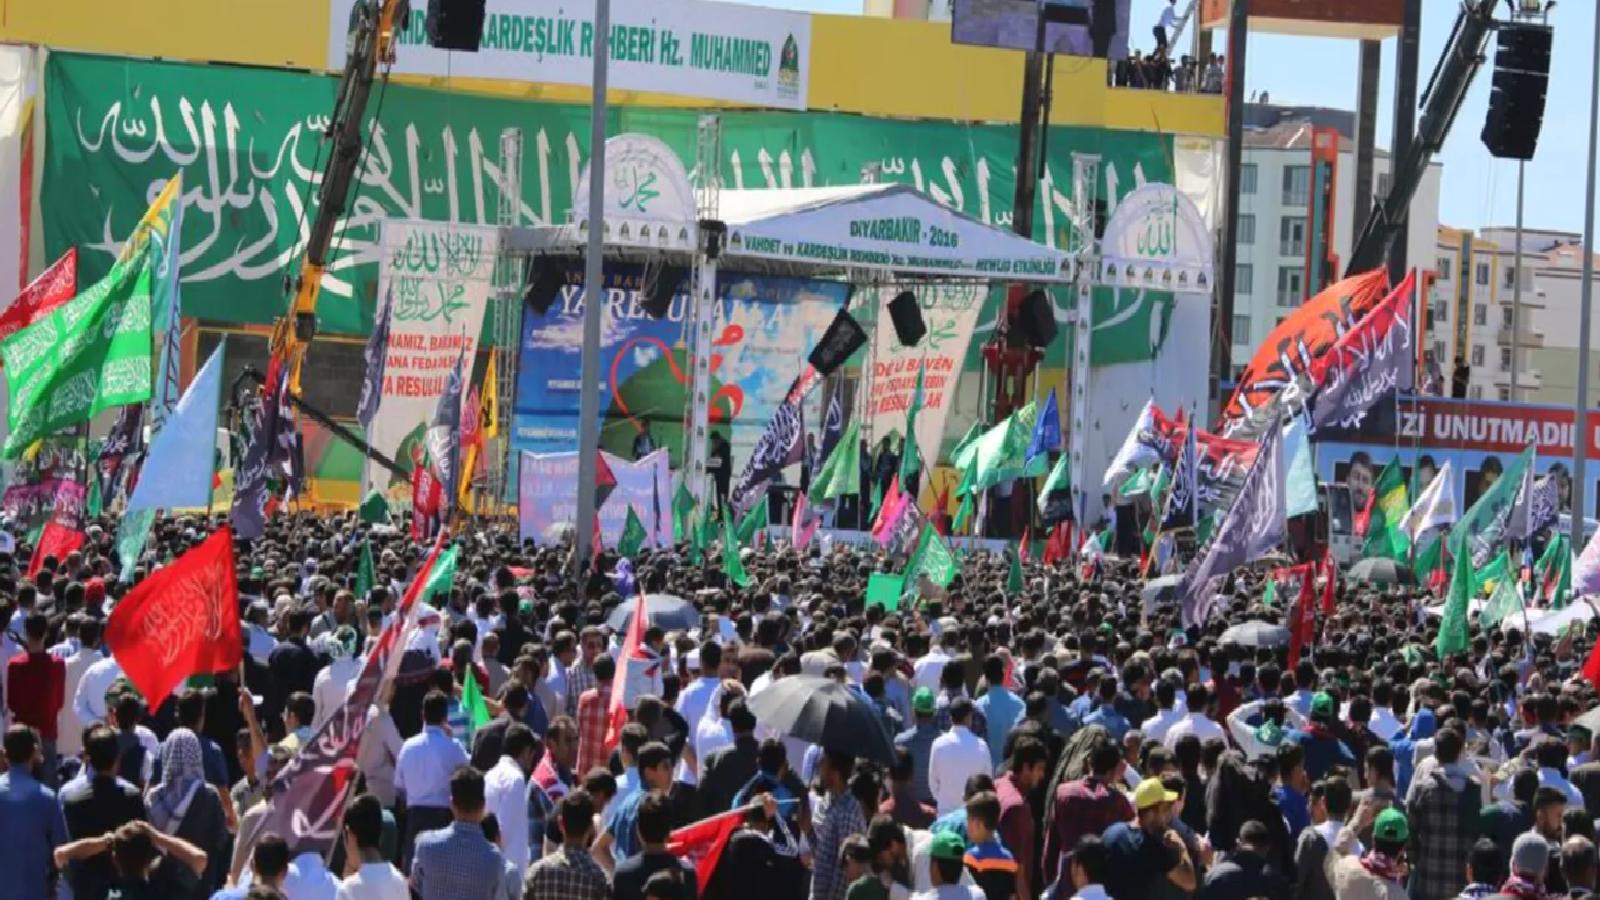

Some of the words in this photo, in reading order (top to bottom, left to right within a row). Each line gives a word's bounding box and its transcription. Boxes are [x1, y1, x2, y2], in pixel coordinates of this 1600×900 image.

[580, 18, 656, 63] RHBERİ
[659, 30, 683, 66] Hz.
[690, 32, 771, 77] MUHAMMED
[929, 225, 957, 248] 2016
[387, 356, 408, 368] ANA
